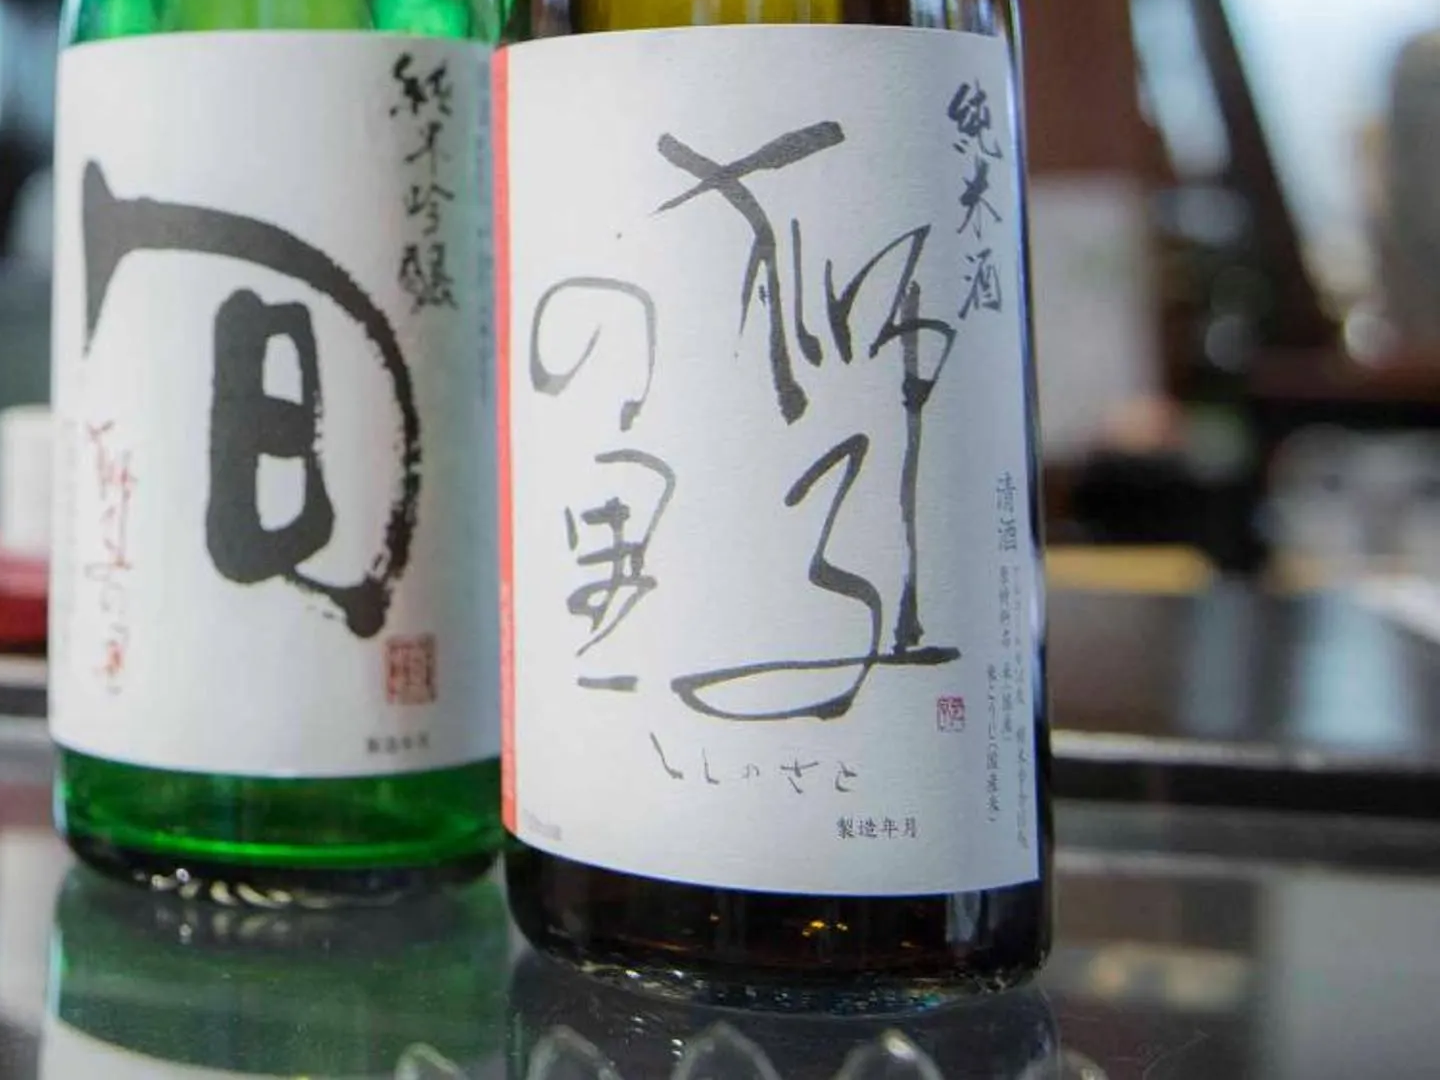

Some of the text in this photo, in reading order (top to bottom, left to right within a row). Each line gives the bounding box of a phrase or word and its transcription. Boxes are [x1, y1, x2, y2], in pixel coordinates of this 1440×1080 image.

[948, 77, 1004, 321] 純米酒
[81, 158, 423, 640] 旬
[834, 816, 918, 840] 製造年月
